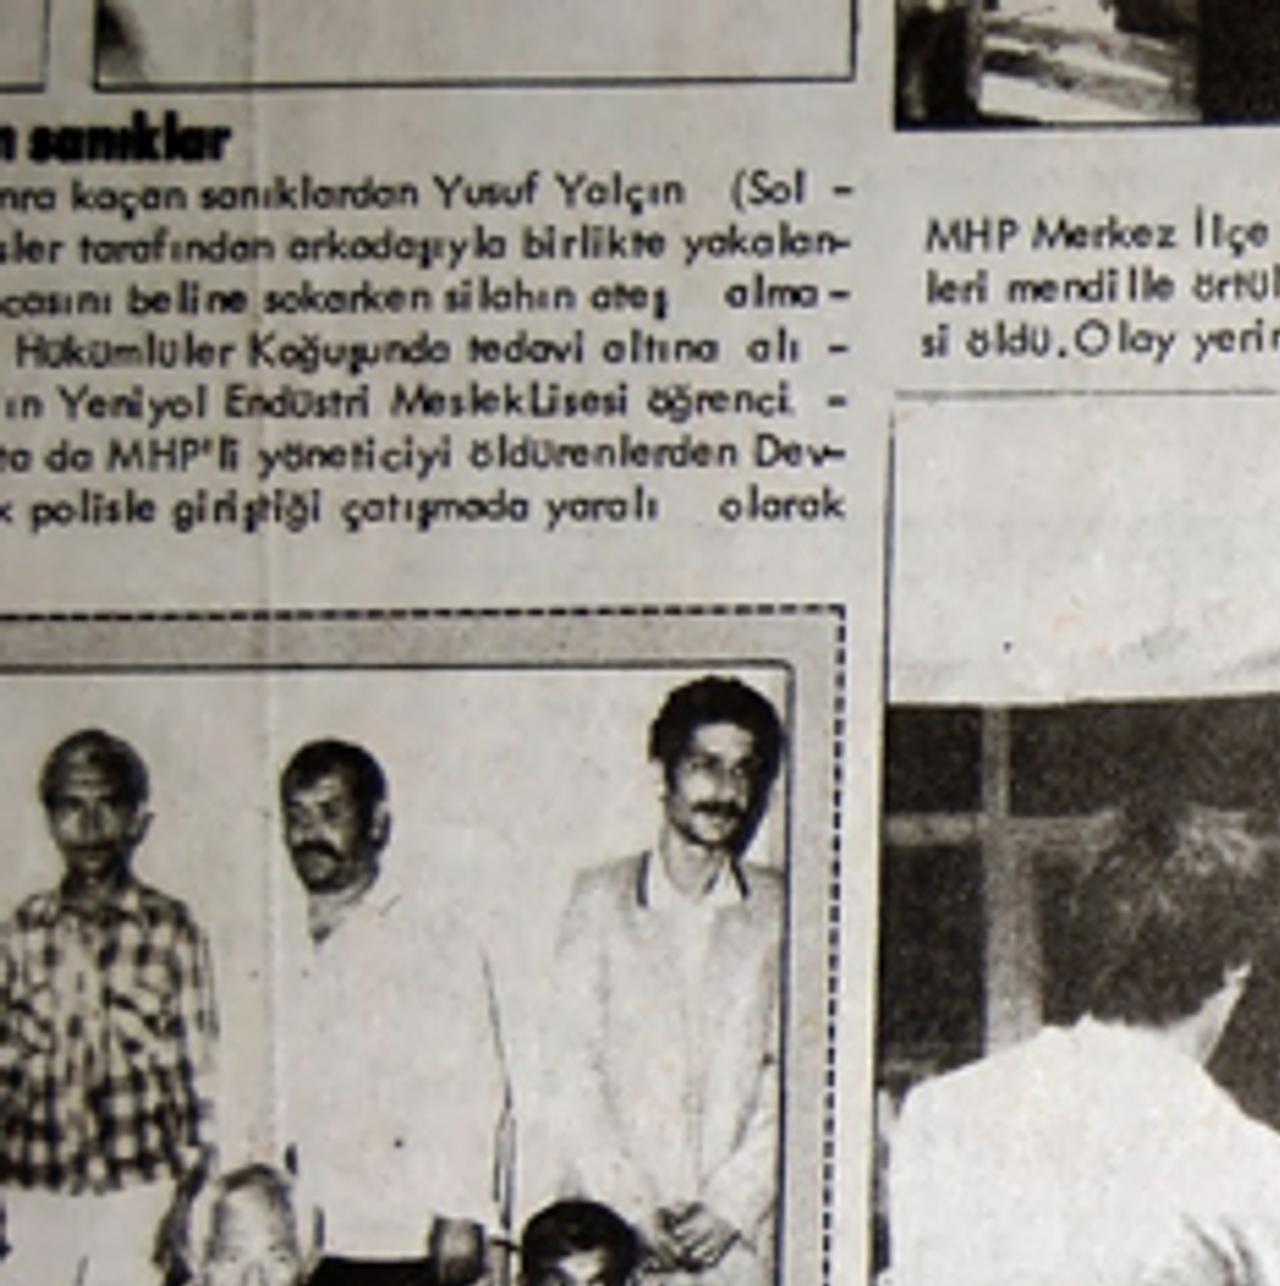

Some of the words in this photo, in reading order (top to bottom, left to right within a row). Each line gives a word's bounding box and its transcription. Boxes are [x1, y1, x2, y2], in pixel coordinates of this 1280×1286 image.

[70, 177, 188, 222] kaçan
[197, 172, 419, 212] sanıklardan
[431, 169, 540, 210] Yusuf
[554, 170, 686, 217] Yalçın
[77, 225, 276, 265] tarafından
[285, 224, 507, 271] arkadaşıyla
[521, 222, 666, 260] birlikte
[925, 215, 1020, 253] MHP
[1031, 214, 1177, 250] Merkez
[126, 279, 249, 317] beline
[263, 279, 432, 315] sokarken
[443, 274, 576, 314] silahın
[588, 282, 668, 321] ateş
[926, 268, 988, 305] leri
[245, 328, 451, 377] Koğuşunda
[466, 329, 584, 364] tedavi
[601, 327, 719, 364] altına
[920, 322, 950, 358] si
[55, 383, 207, 430] Yeniyol
[223, 381, 369, 419] Endüstri
[43, 438, 94, 474] da
[105, 433, 239, 472] MHP'li
[256, 433, 451, 483] yöneticiyi
[467, 432, 738, 470] öldürenlerden
[28, 487, 156, 534] polisle
[170, 487, 321, 534] giriştiği
[339, 487, 530, 534] çatışmada
[544, 483, 658, 532] yaralı
[717, 482, 845, 523] olarak
